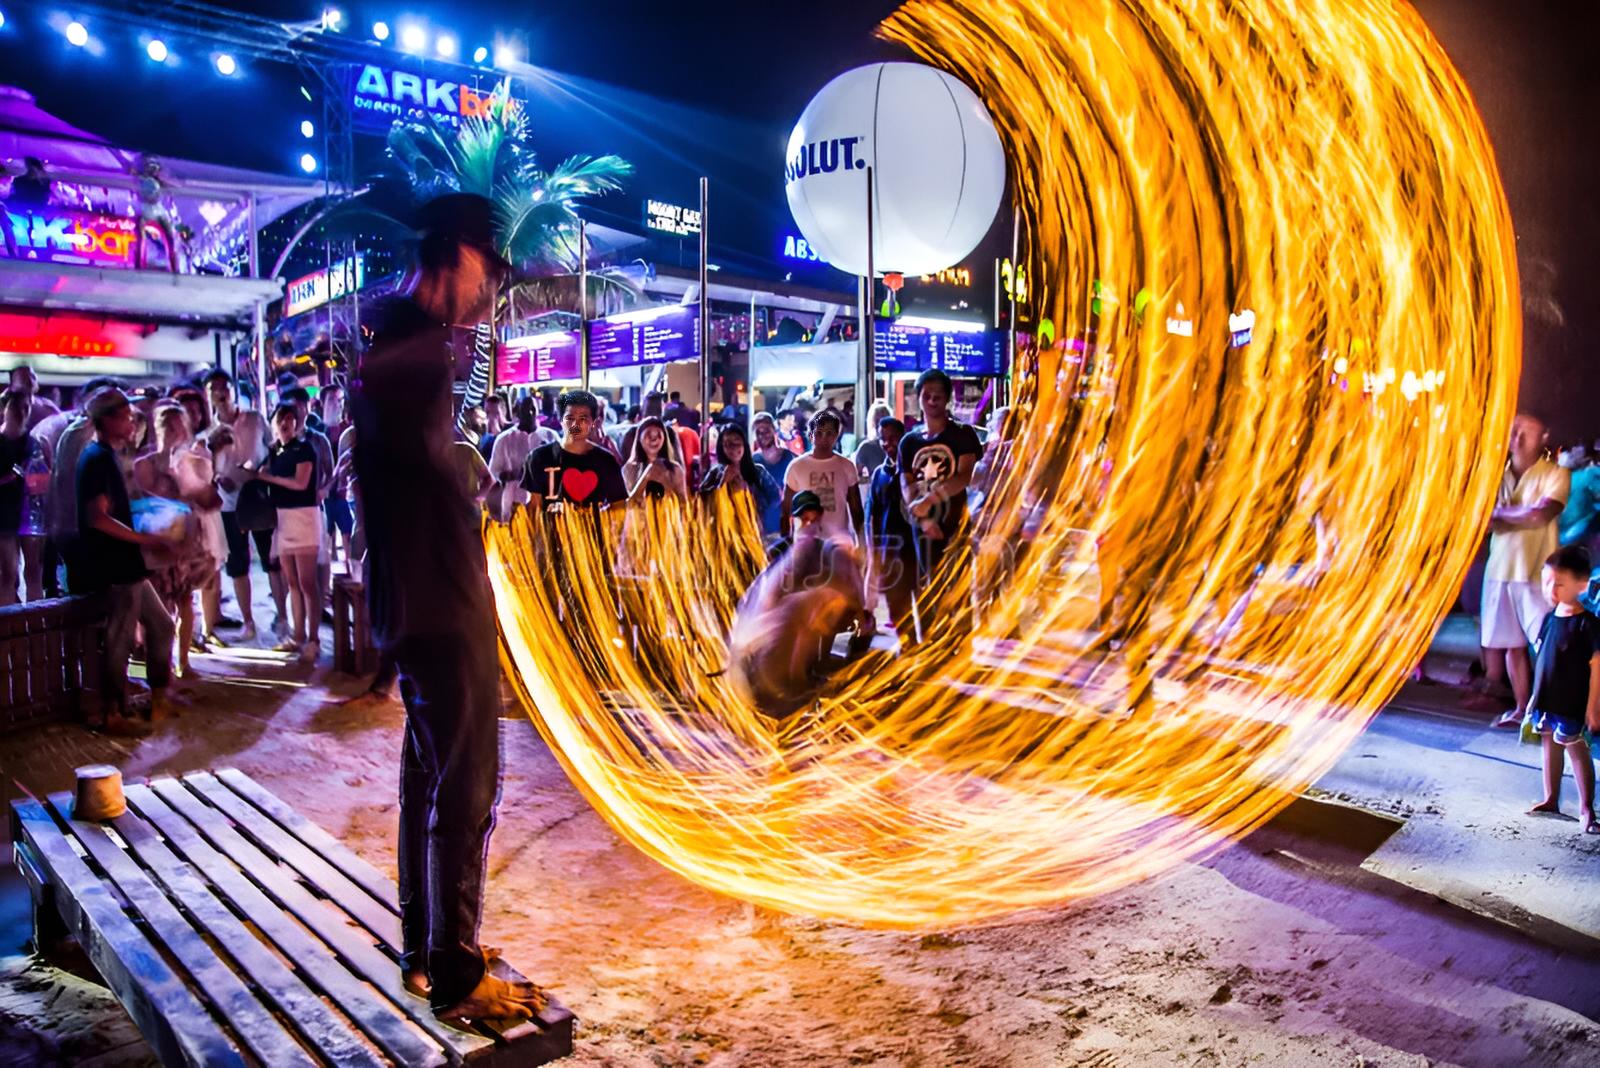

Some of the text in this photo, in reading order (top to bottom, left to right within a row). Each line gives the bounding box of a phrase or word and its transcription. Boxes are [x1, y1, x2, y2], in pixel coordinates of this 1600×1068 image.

[355, 64, 458, 113] ARK
[74, 219, 137, 260] bar
[543, 466, 561, 500] I
